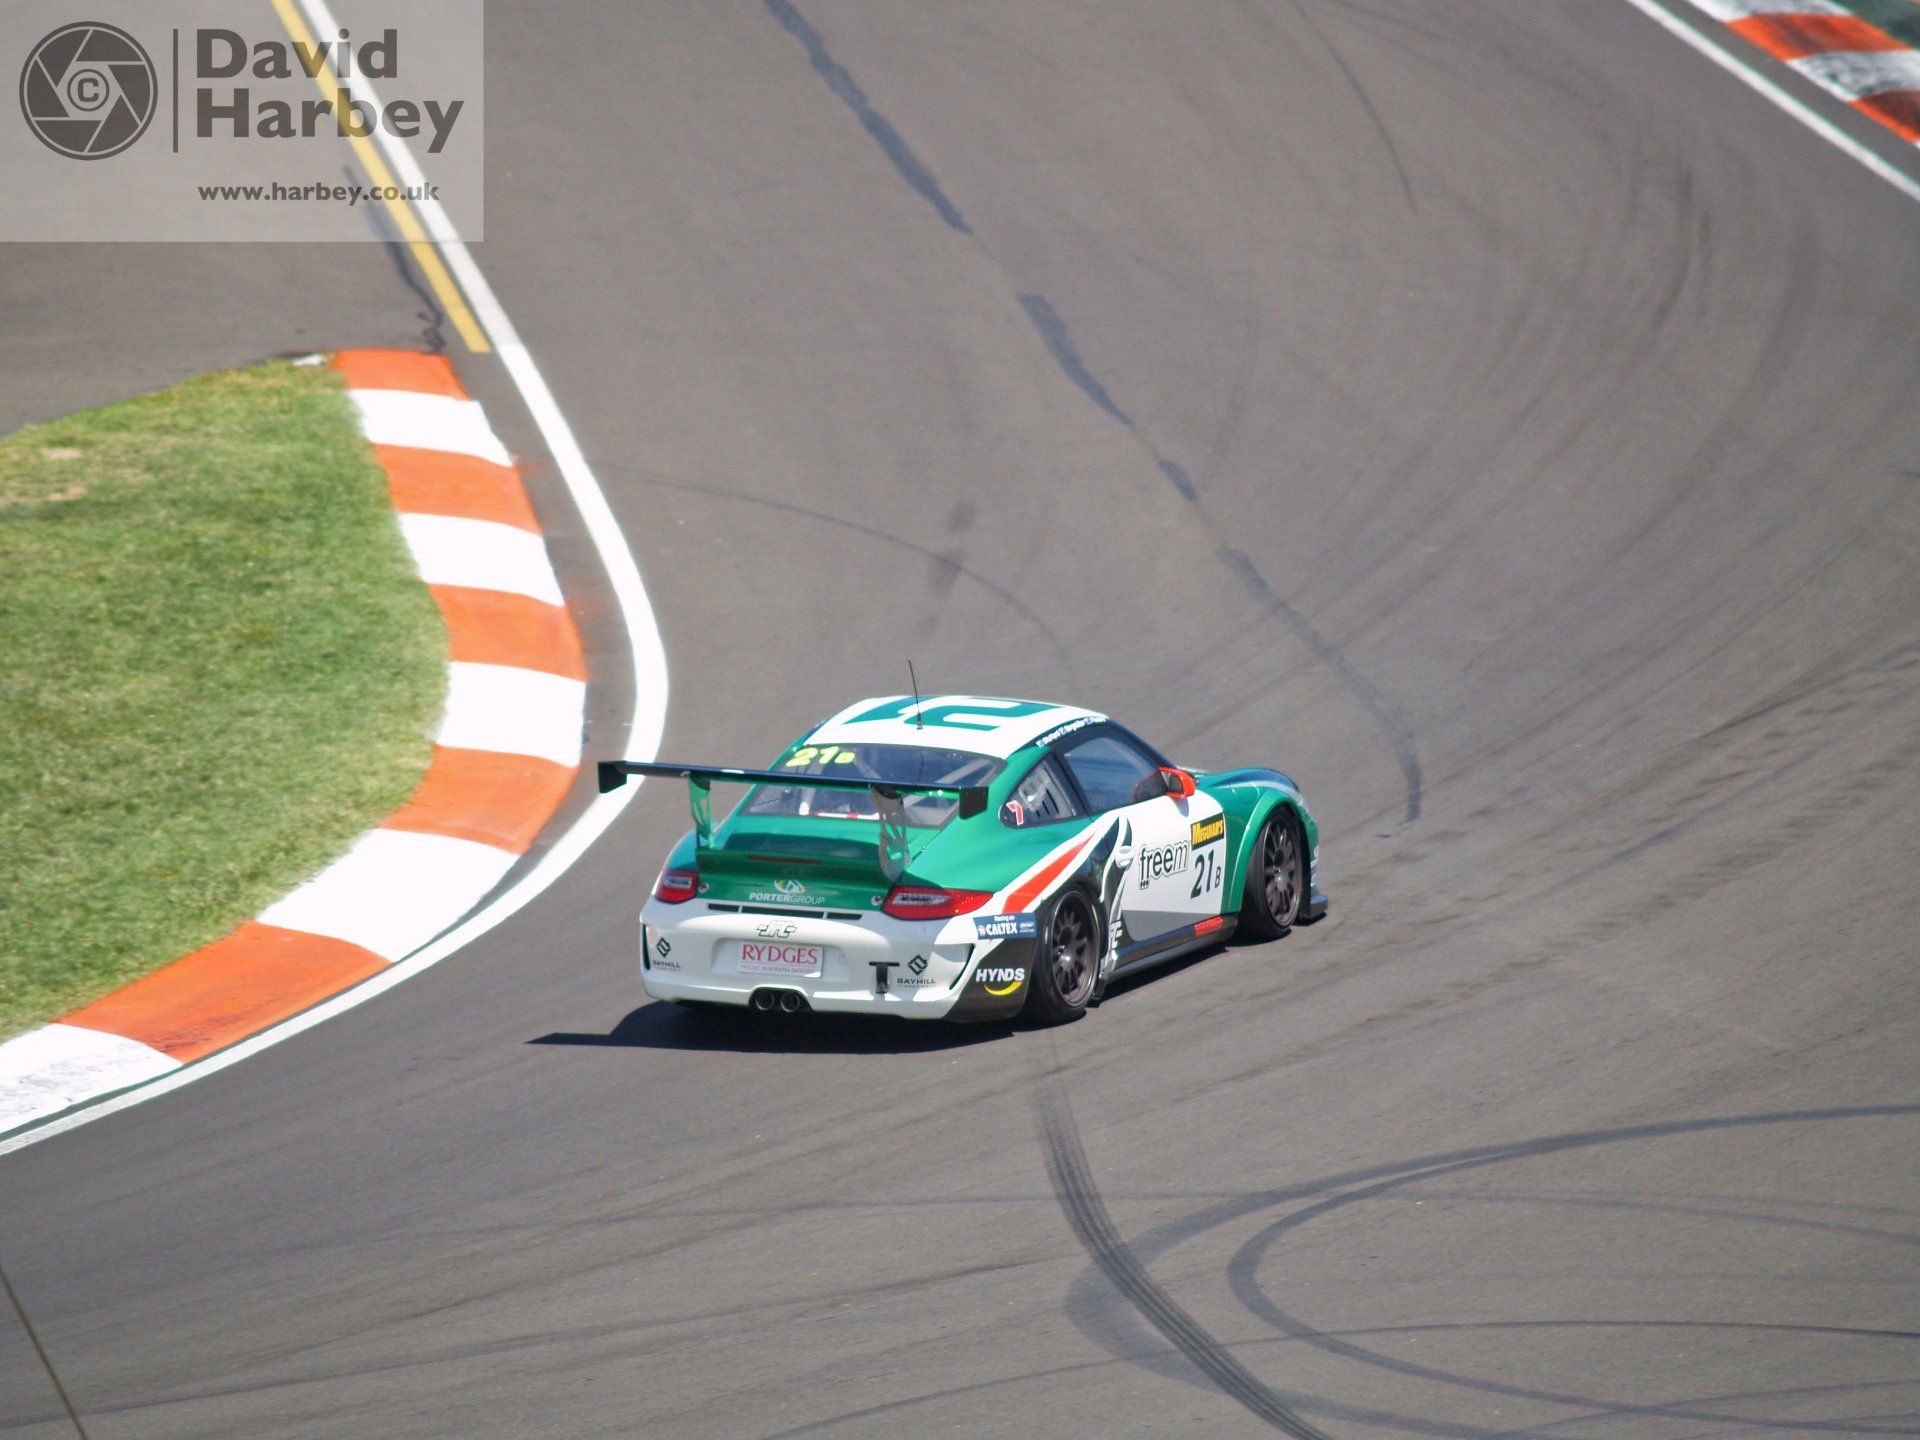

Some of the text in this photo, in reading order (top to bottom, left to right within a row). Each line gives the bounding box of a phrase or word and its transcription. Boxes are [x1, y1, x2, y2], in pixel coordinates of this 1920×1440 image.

[986, 923, 1018, 935] CALTEX
[741, 944, 818, 965] RYDGES
[975, 968, 1025, 982] HYNDS
